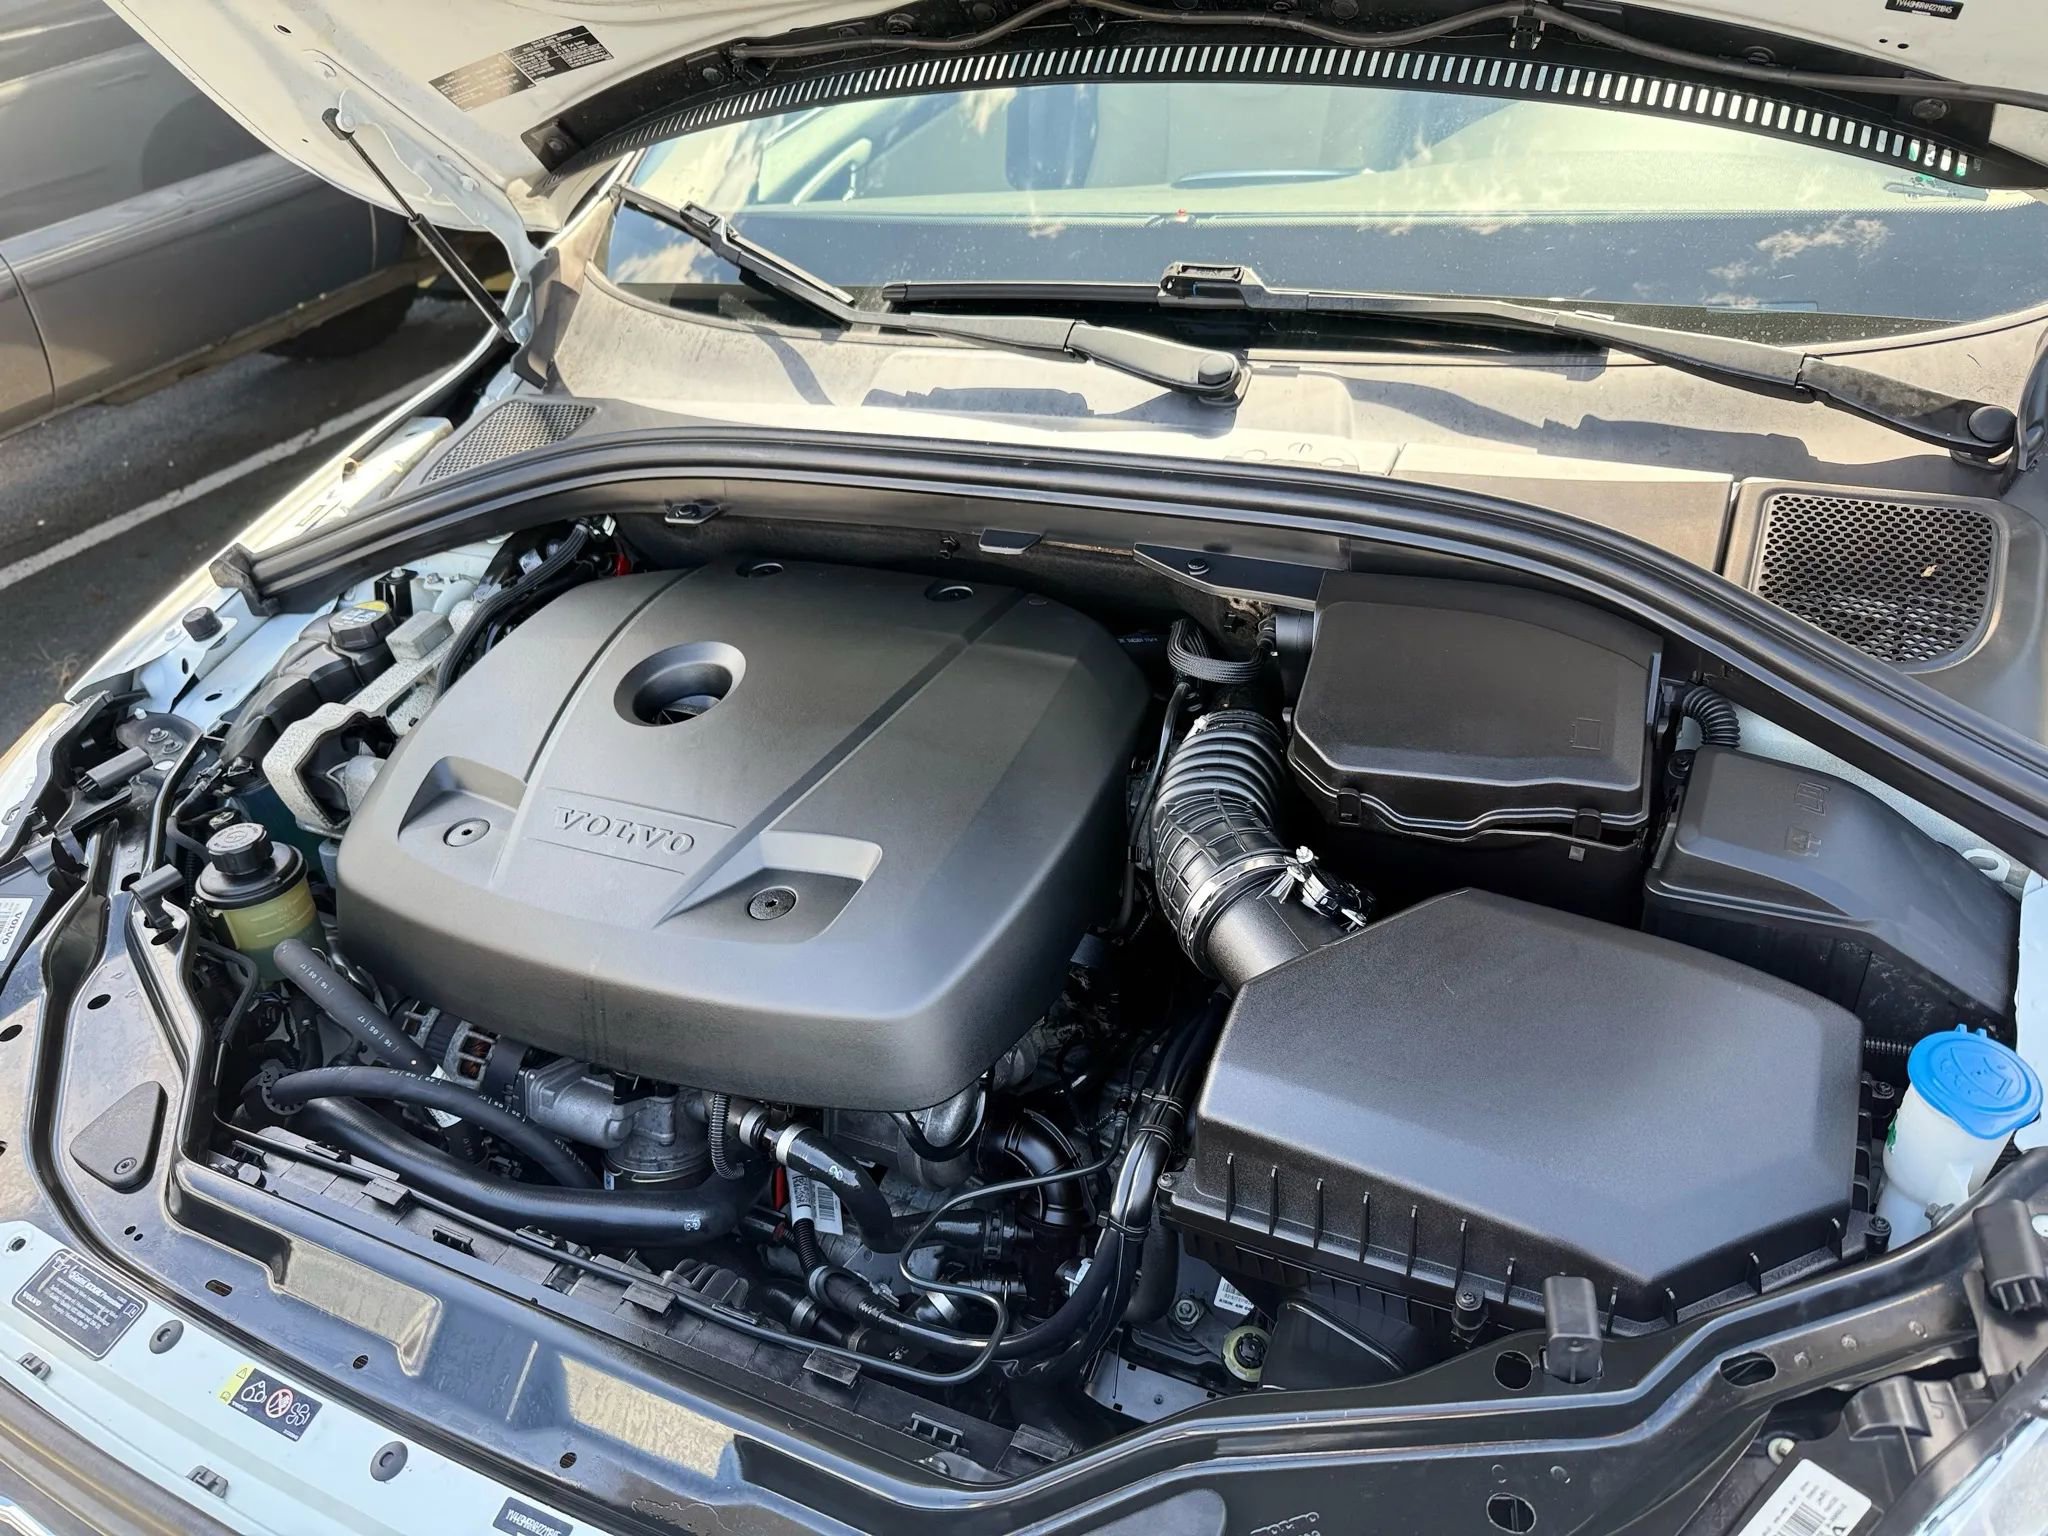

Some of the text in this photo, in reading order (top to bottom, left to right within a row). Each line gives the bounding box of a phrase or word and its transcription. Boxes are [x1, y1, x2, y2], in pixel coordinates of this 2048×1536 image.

[553, 805, 695, 856] VOLVO
[2, 911, 23, 945] VOLVO
[357, 1015, 393, 1047] 16 05 17
[22, 1291, 42, 1306] VOLVO
